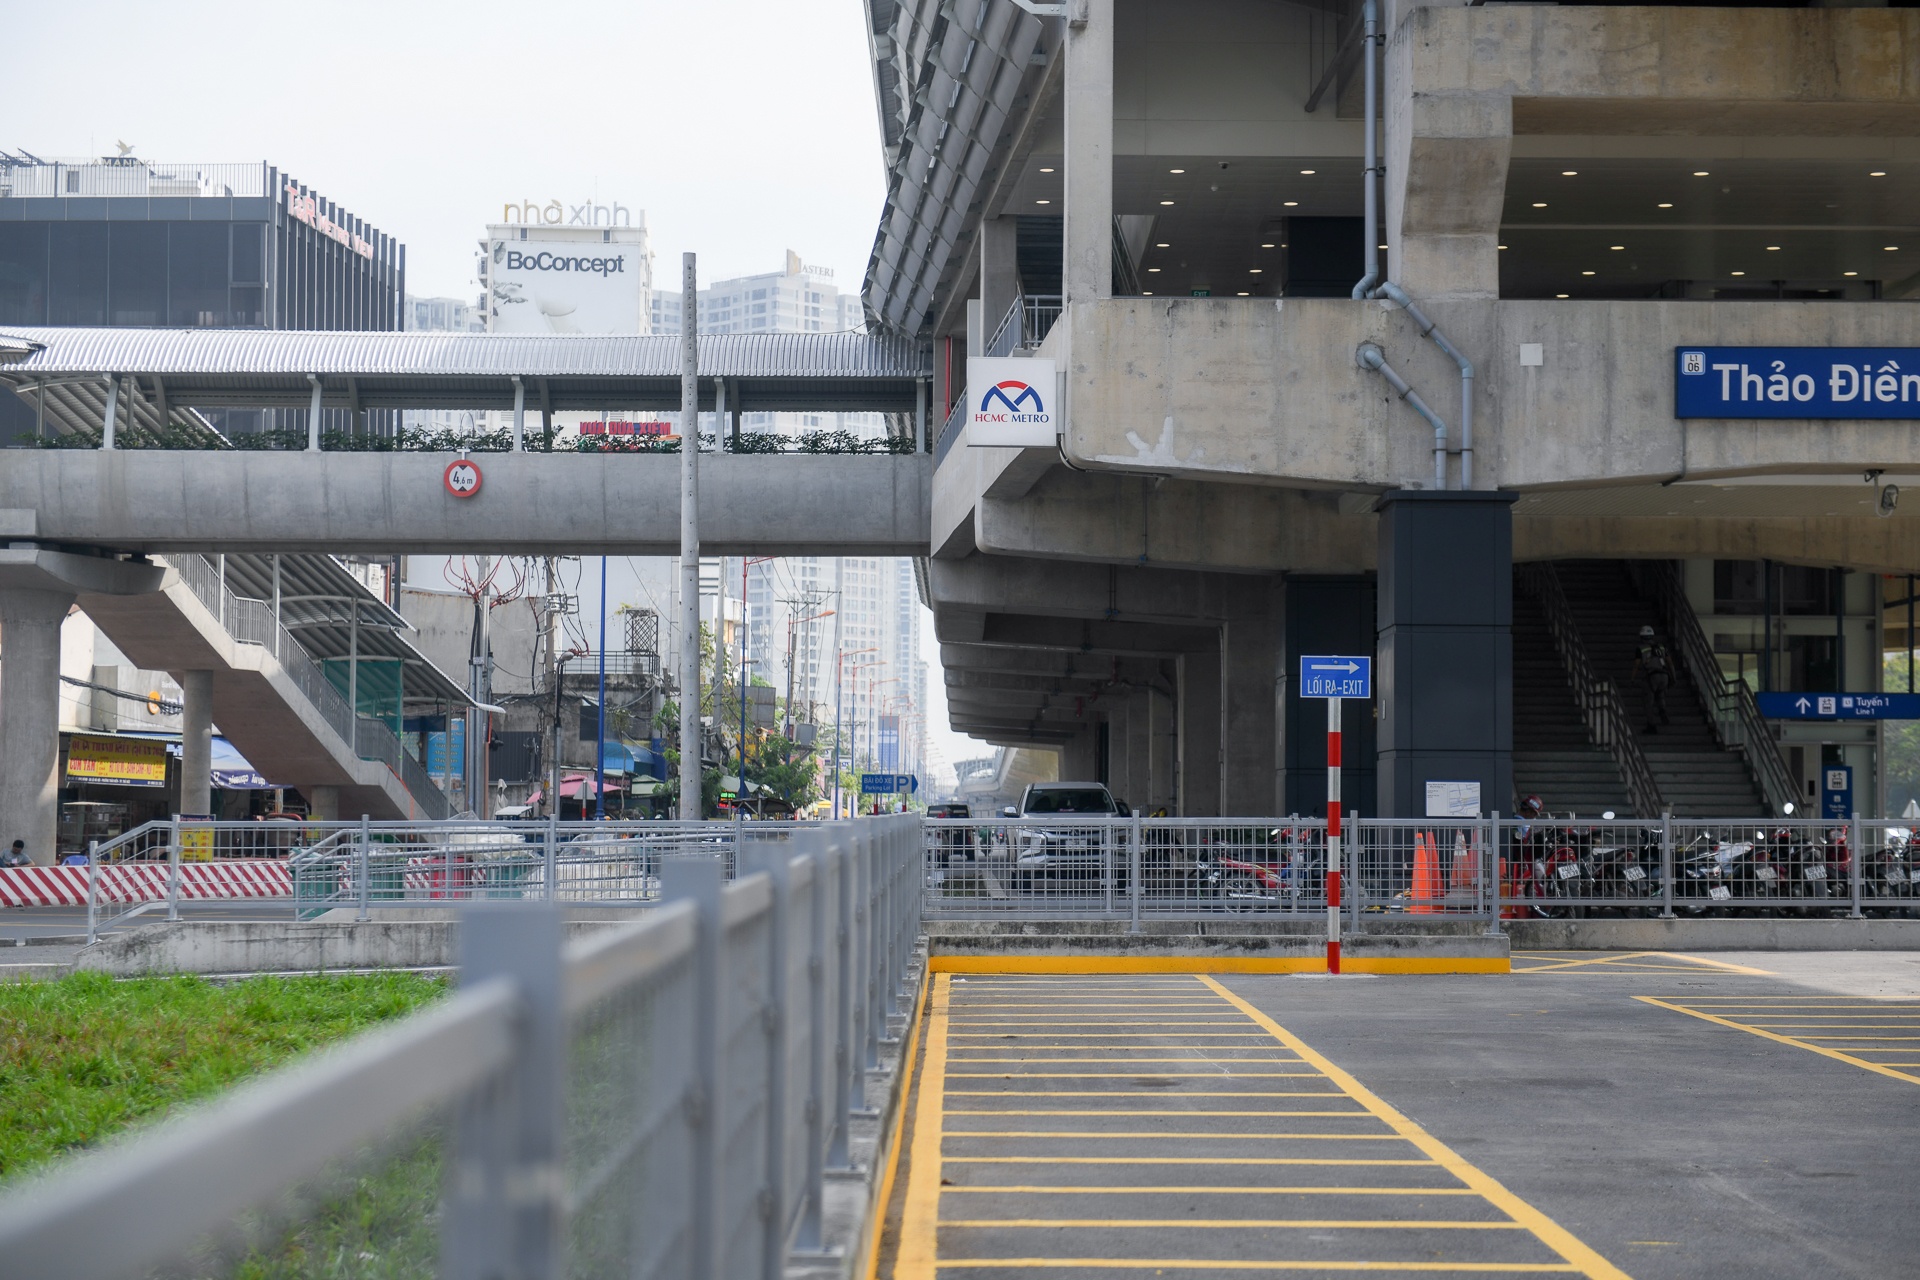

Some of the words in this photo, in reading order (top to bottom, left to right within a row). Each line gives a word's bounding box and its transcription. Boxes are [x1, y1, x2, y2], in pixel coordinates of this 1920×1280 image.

[504, 199, 563, 225] nhà
[568, 198, 630, 226] xinh
[350, 231, 374, 260] VIEW
[507, 250, 625, 278] BoConcept
[1687, 362, 1700, 373] 06
[1712, 360, 1816, 402] Thảo
[1828, 360, 1920, 402] Điền
[975, 413, 1008, 423] HCMC
[1011, 413, 1050, 424] METRO
[1307, 674, 1322, 695] LỐI
[896, 776, 909, 792] P
